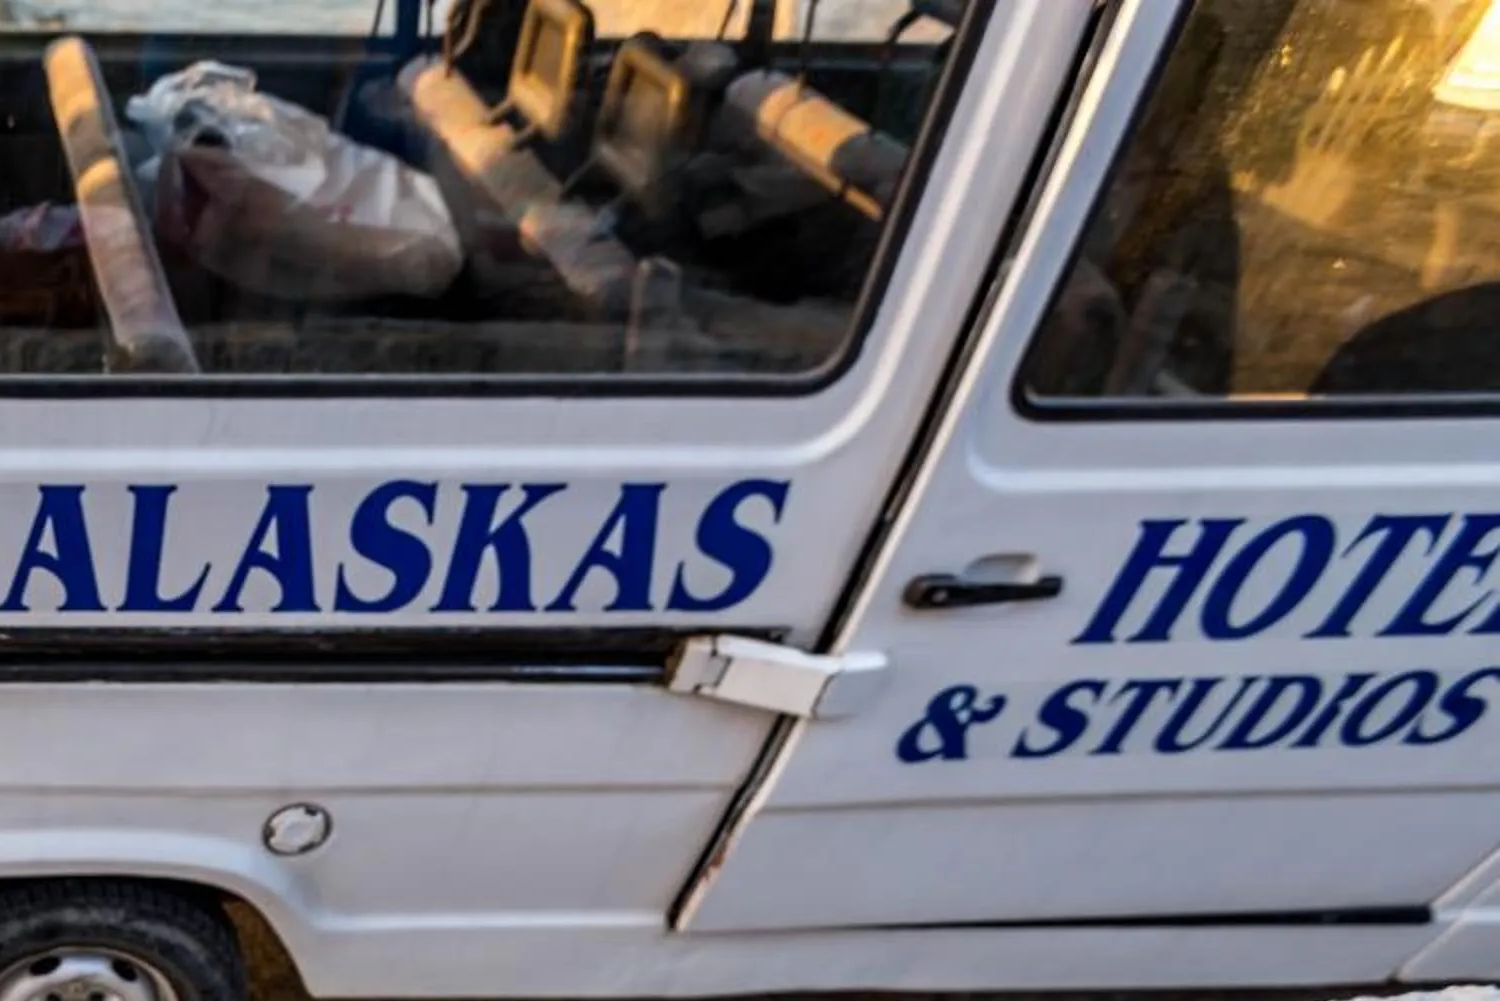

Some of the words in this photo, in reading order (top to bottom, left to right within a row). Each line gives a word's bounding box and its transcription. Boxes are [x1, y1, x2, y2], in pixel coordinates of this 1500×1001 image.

[1068, 512, 1500, 645] HOTE
[895, 684, 1007, 763] &
[1010, 666, 1500, 759] STUDIOS
